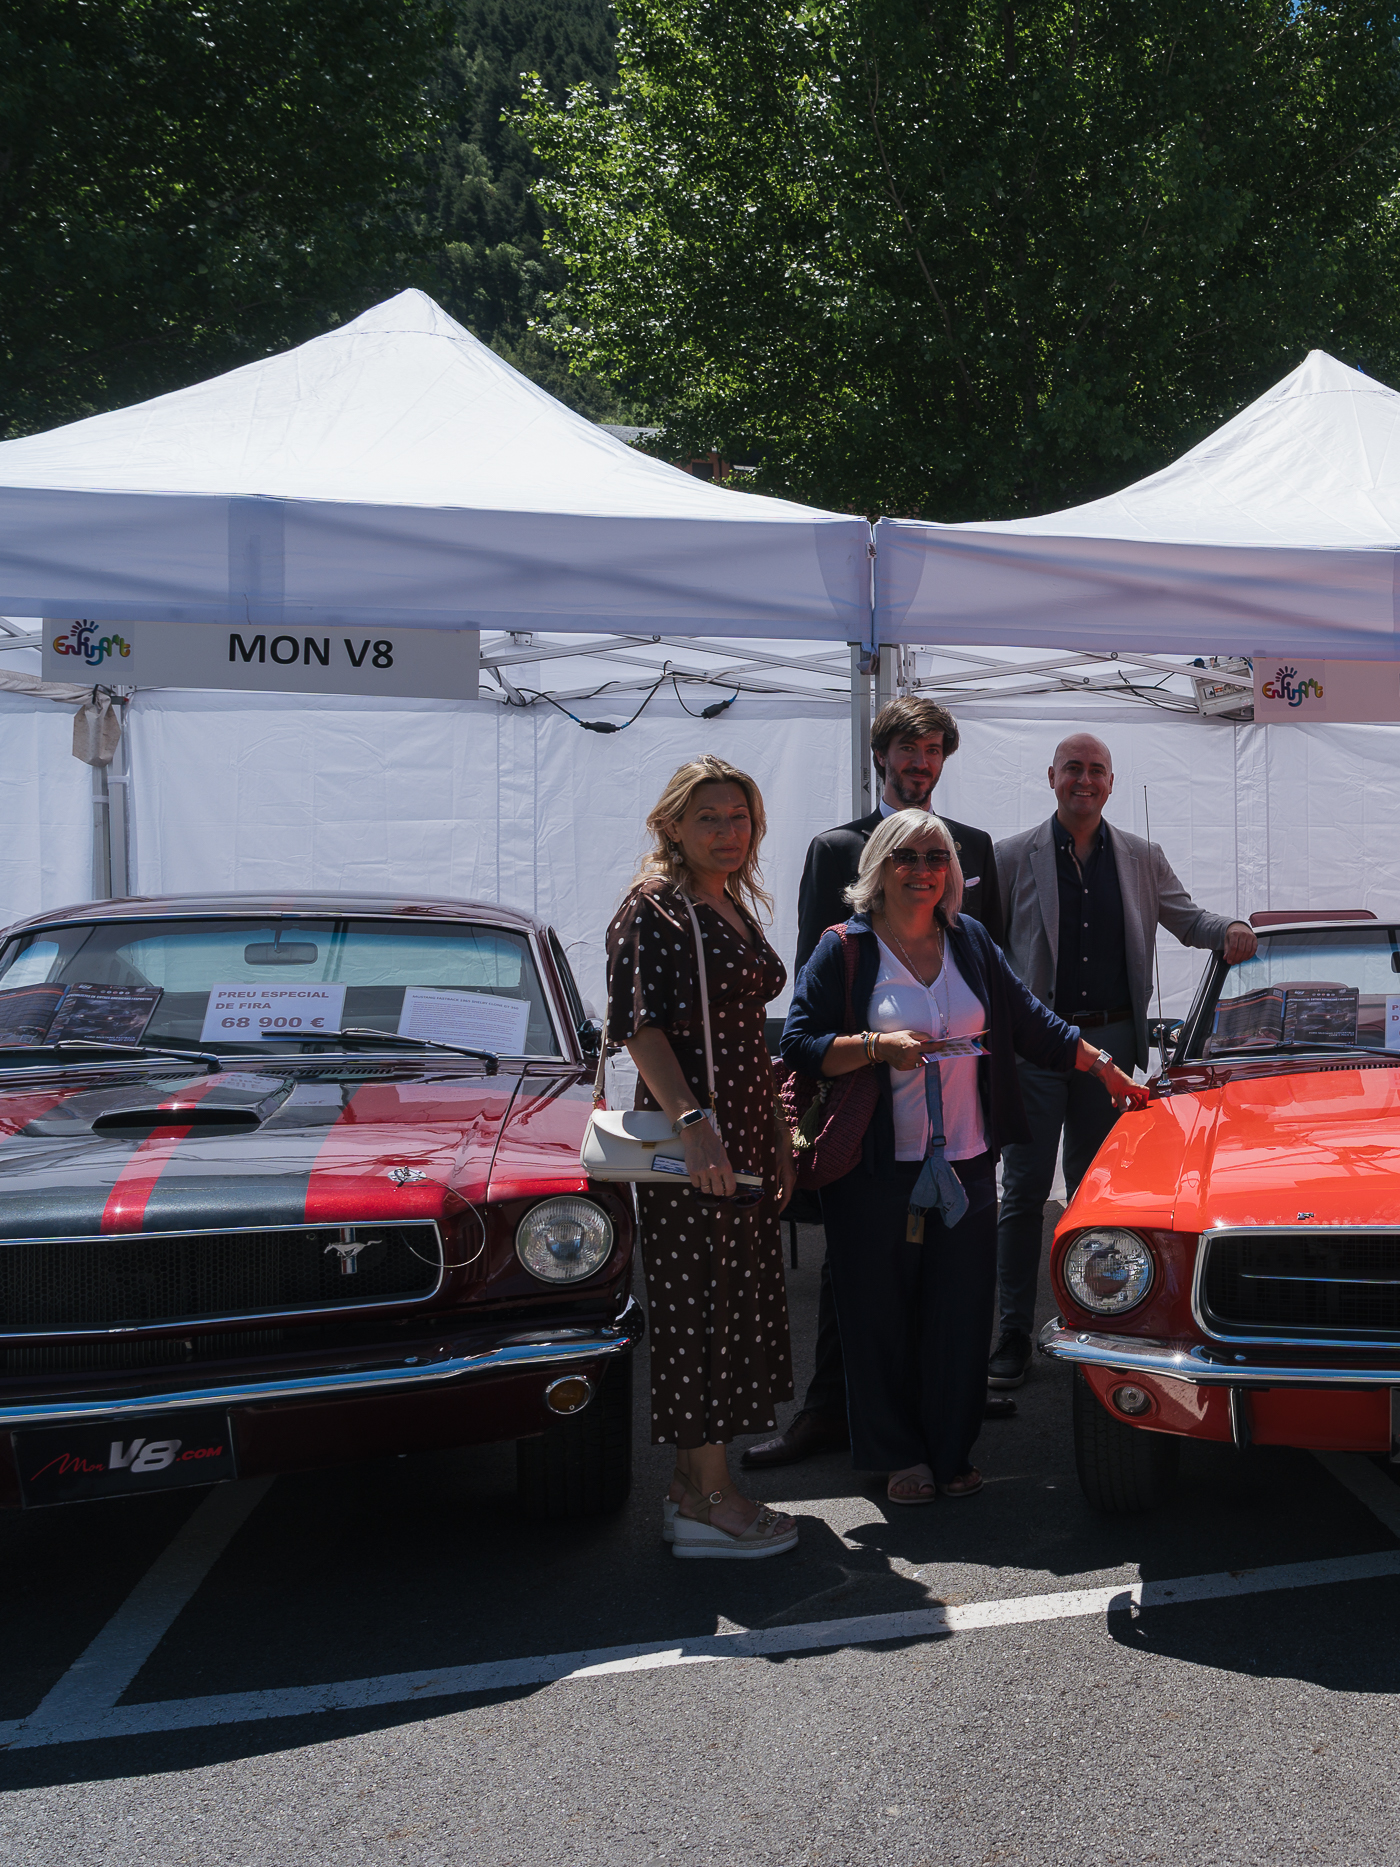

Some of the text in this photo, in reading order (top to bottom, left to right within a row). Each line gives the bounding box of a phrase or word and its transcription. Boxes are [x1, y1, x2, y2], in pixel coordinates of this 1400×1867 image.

[228, 633, 394, 669] MON V8
[221, 1017, 325, 1028] 68 900 €
